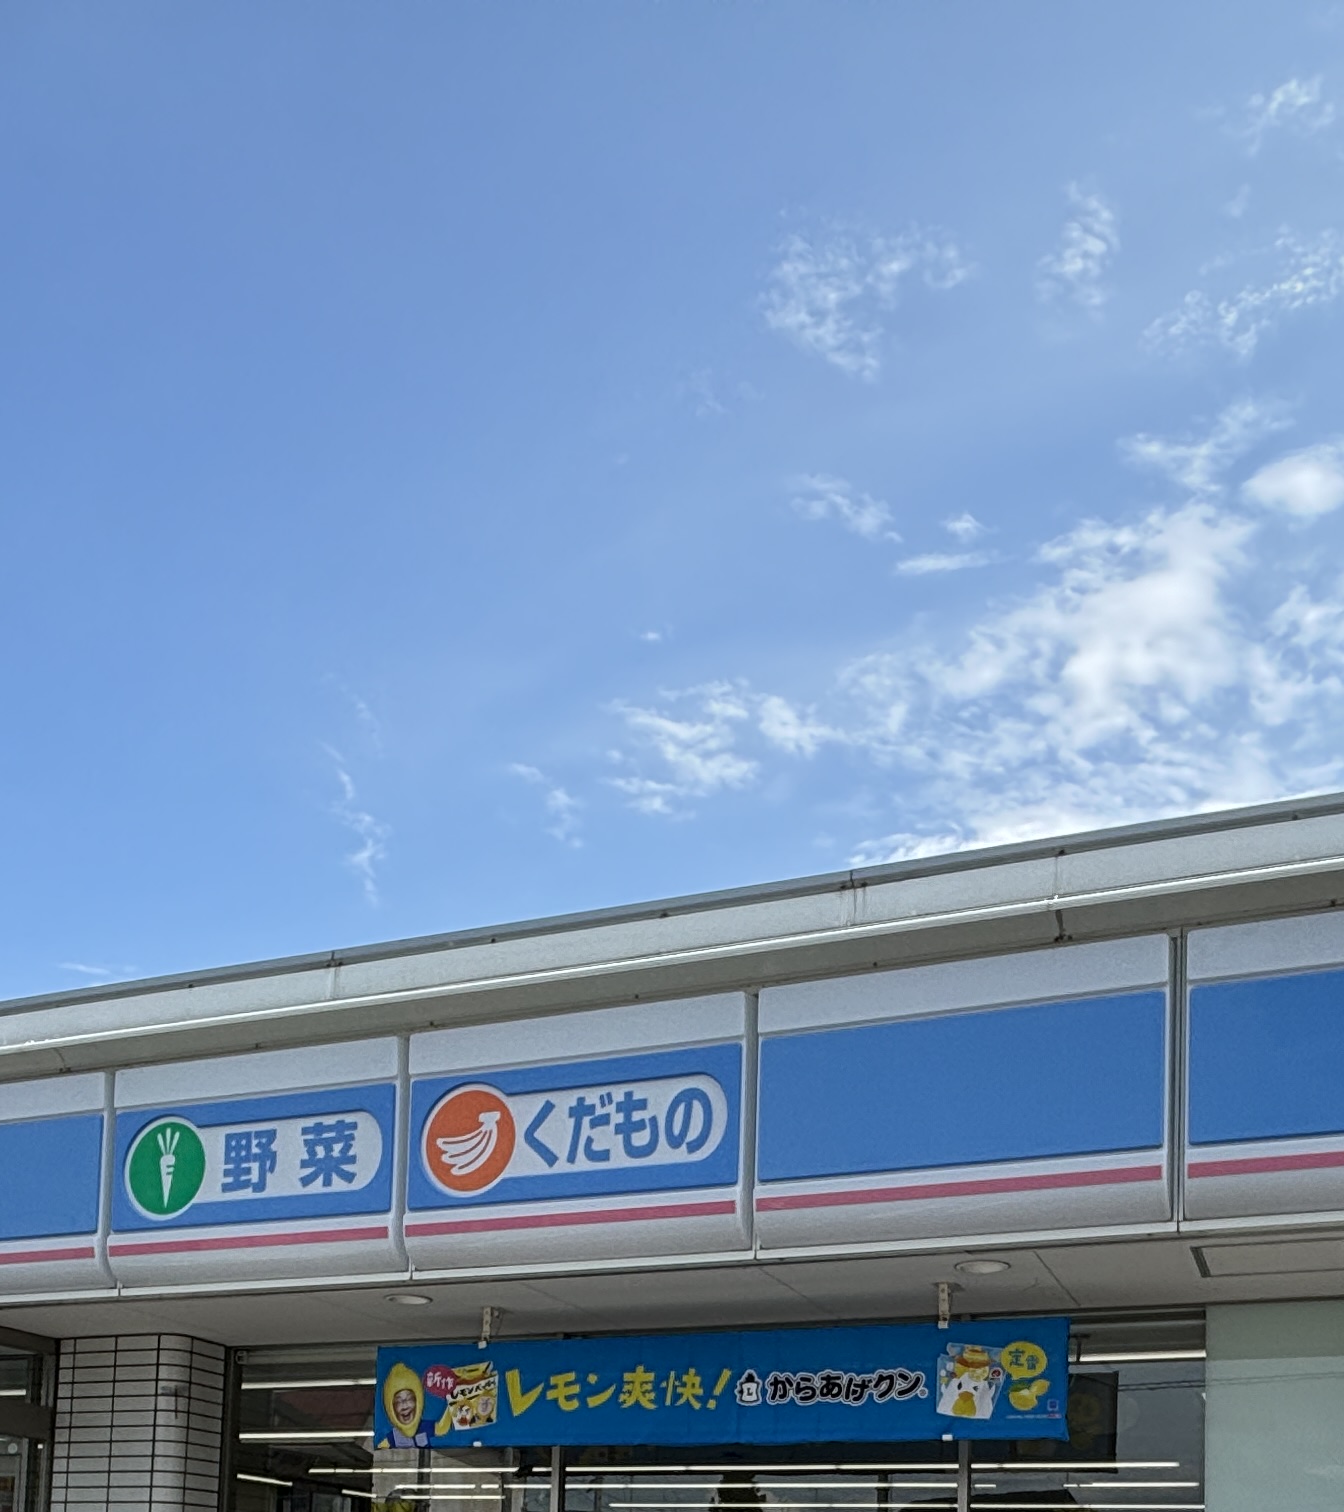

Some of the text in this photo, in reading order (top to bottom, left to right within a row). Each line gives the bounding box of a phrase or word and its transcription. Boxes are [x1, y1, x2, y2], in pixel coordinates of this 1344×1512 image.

[221, 1119, 358, 1193] 野菜
[523, 1086, 714, 1169] くだもの
[426, 1371, 455, 1390] 新作
